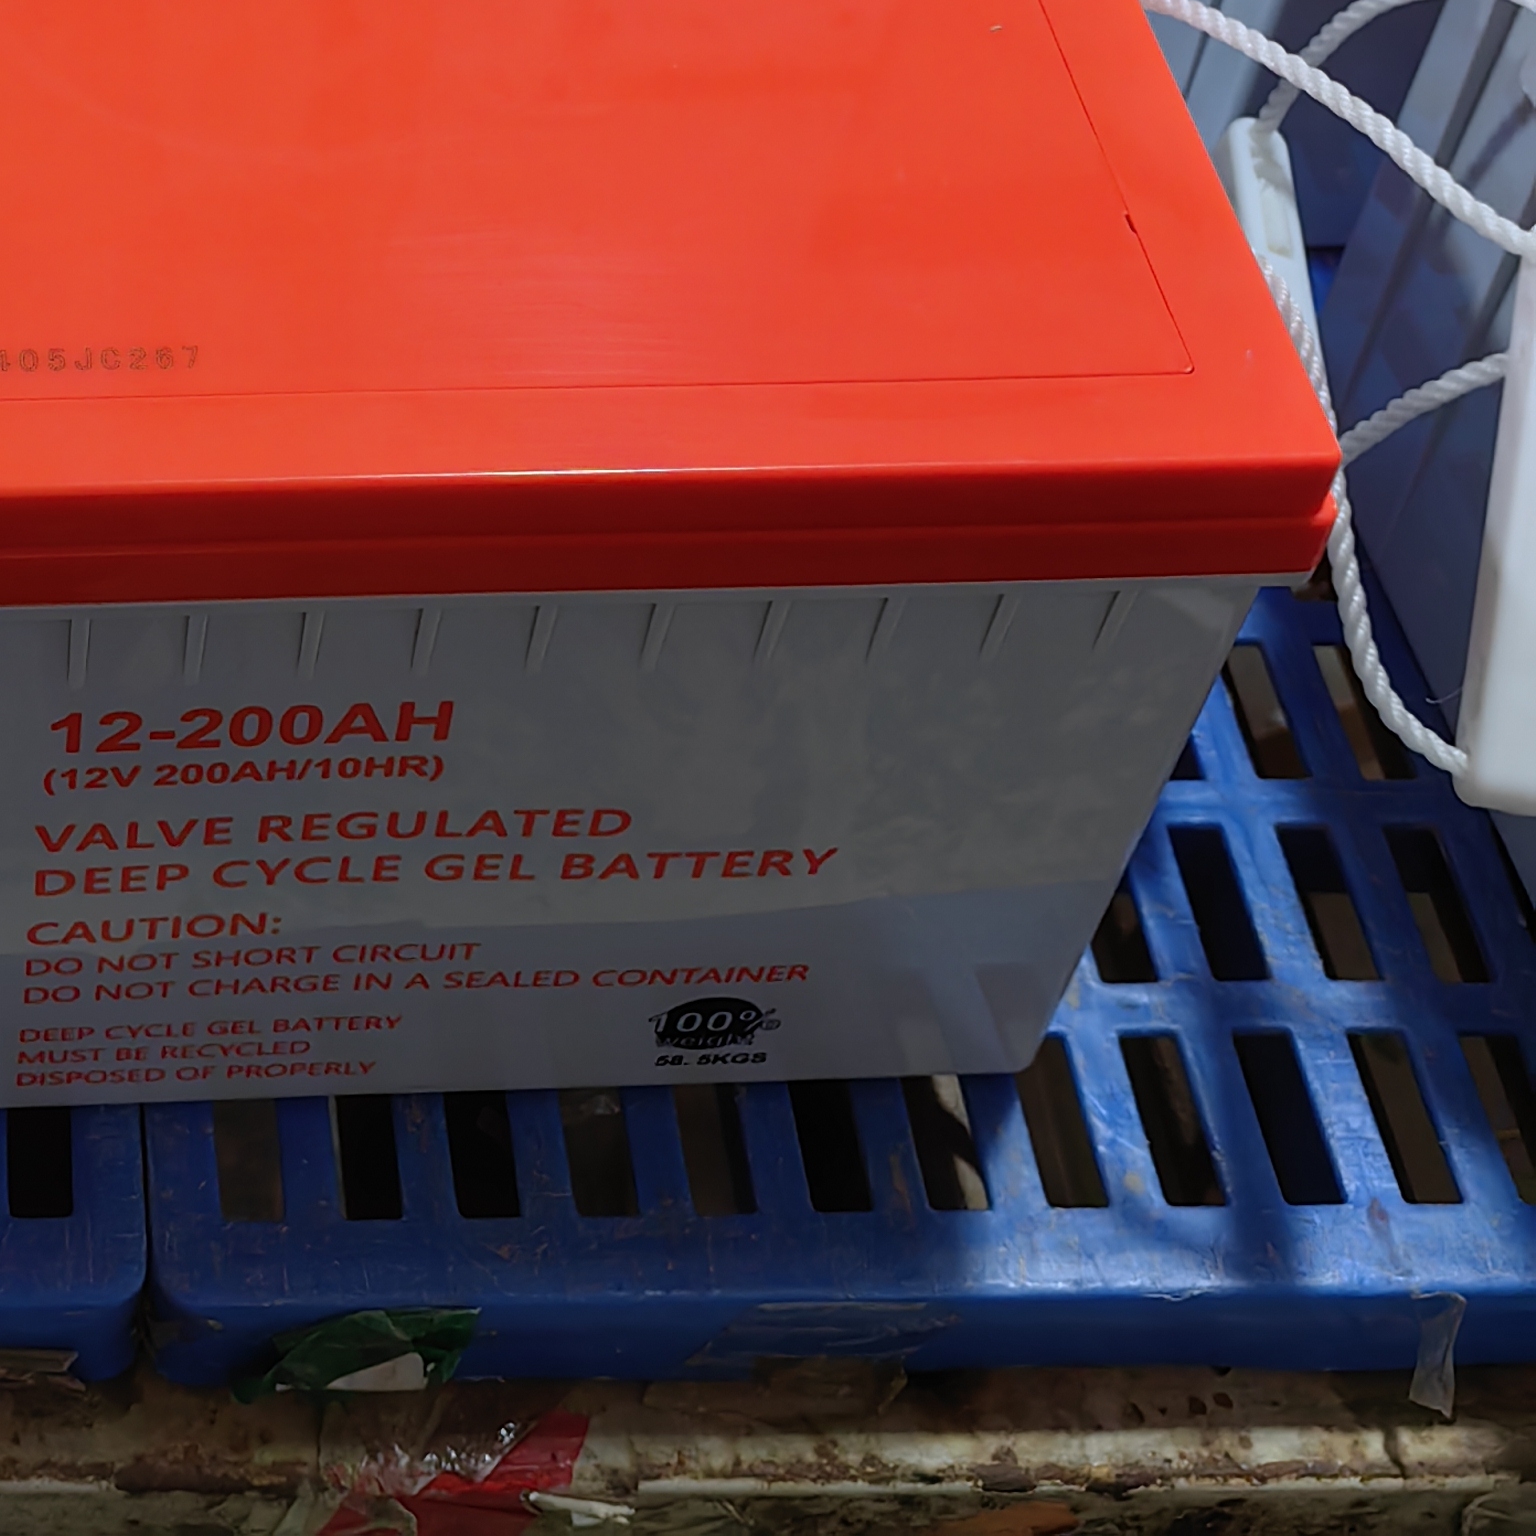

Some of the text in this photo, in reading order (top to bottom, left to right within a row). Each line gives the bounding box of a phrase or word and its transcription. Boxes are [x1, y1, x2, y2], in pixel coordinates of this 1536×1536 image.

[50, 700, 455, 755] 12-200AH
[42, 755, 444, 797] (12V 200AH/10HR)
[34, 808, 632, 854] VALVE REGULATED
[34, 847, 837, 898] DEEP CYCLE GEL BATTERY
[26, 912, 280, 947] CAUTION:
[24, 943, 480, 977] DO NOT SHORT CIRCUIT
[23, 964, 809, 1005] DO NOT CHARGE IN A SEALED CONTAINER
[18, 1016, 401, 1045] DEEP CYCLE GEL BATTERY
[648, 1008, 781, 1032] 100%
[17, 1042, 310, 1065] MUST BE RECYCLED
[16, 1062, 374, 1088] DISPOSED OF PROPERLY
